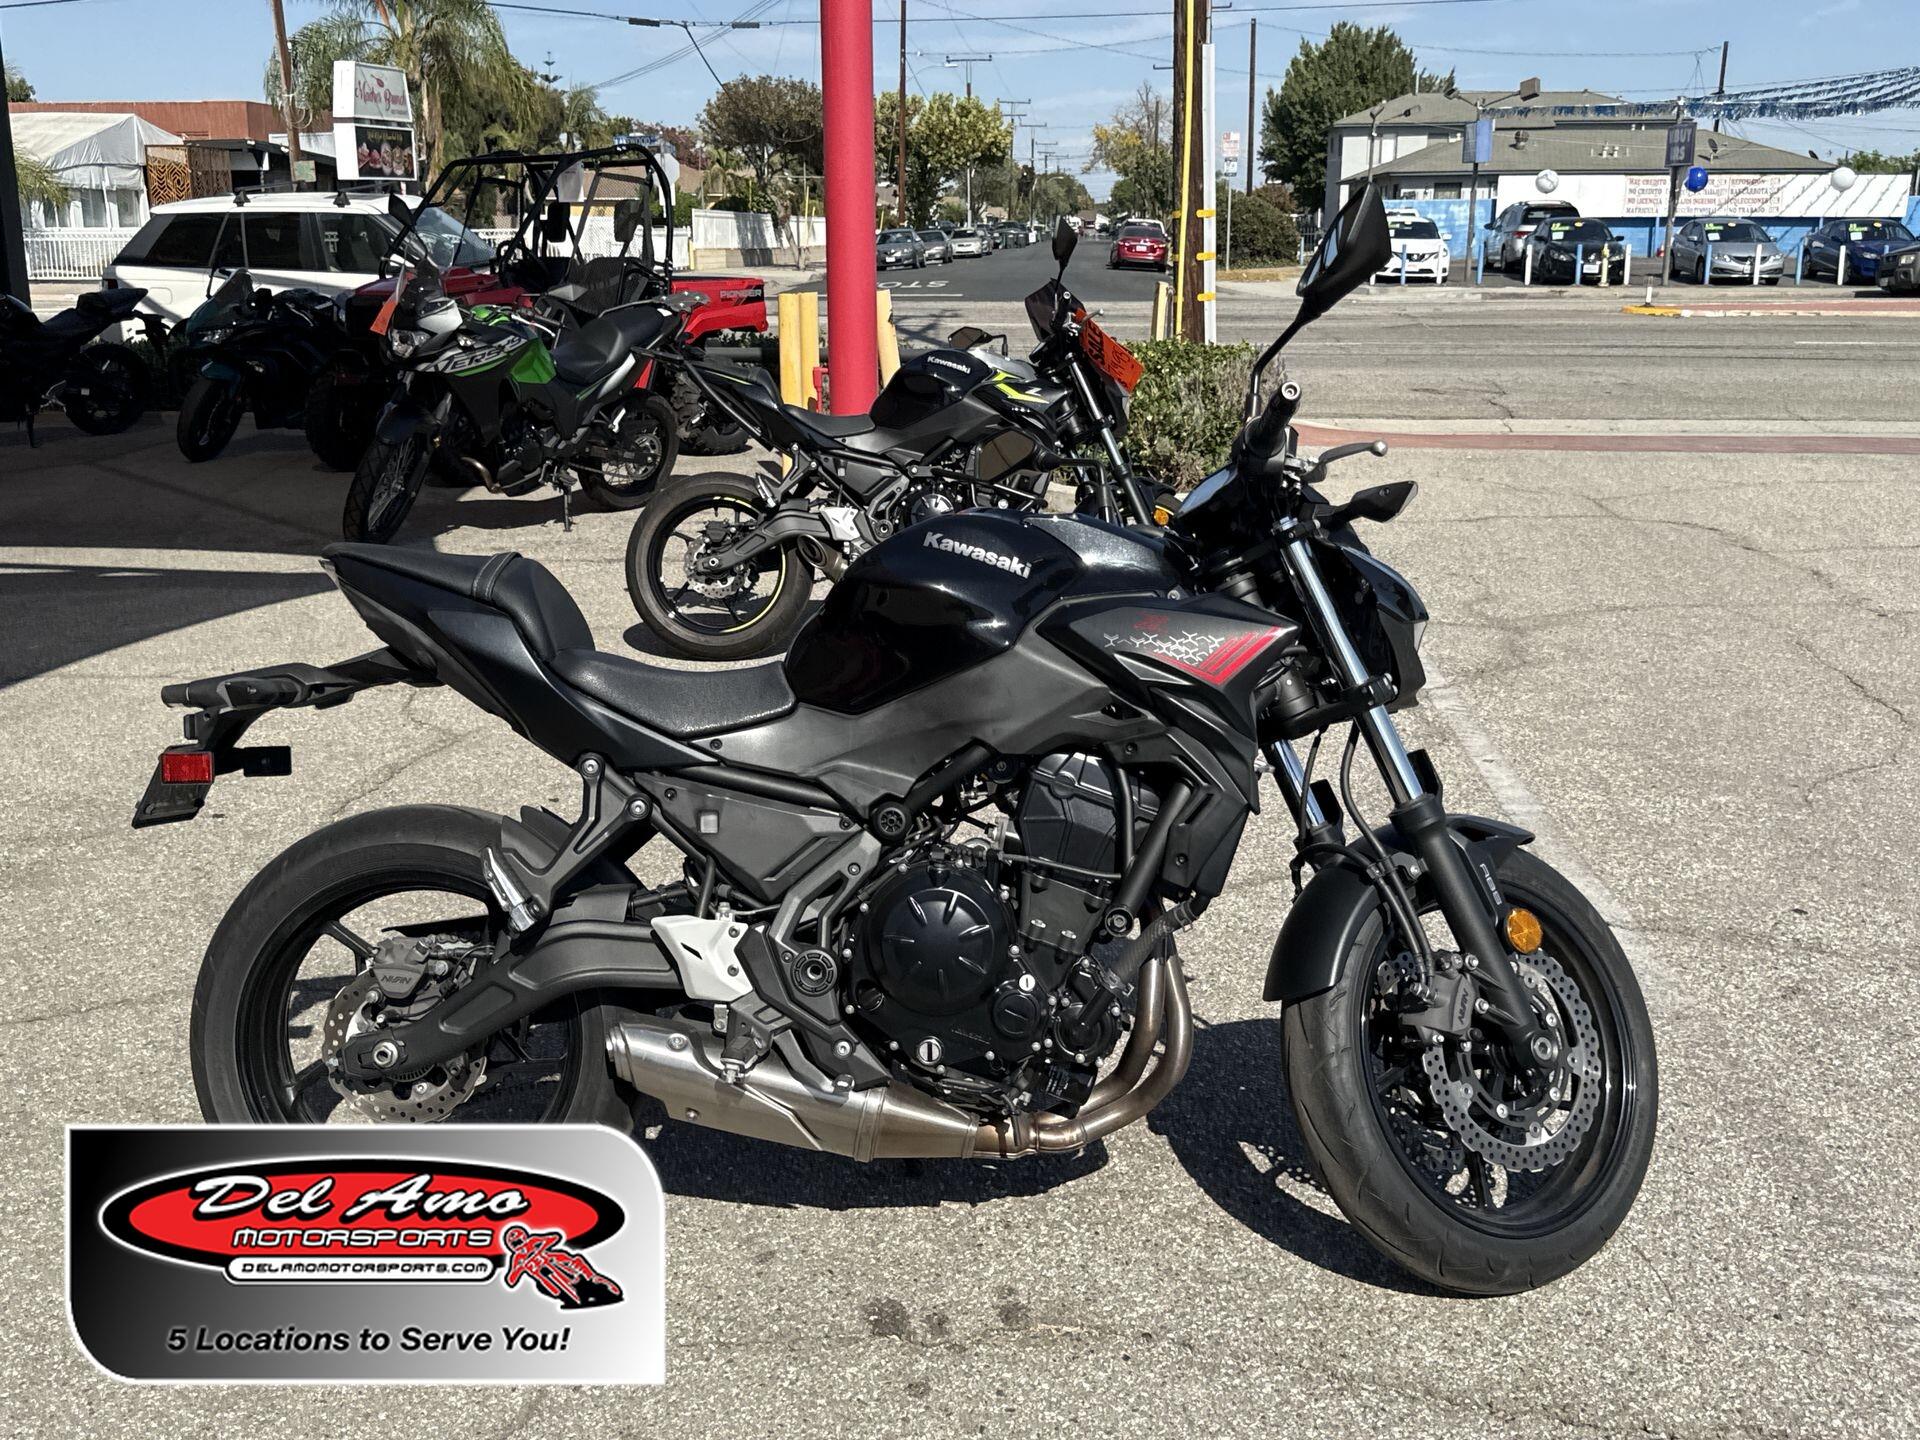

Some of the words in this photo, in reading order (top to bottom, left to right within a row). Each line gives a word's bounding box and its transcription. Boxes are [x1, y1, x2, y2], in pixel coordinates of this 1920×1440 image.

[877, 280, 950, 289] STO
[926, 355, 971, 375] Kawasaki
[923, 531, 1033, 580] Kawasaki
[1480, 863, 1503, 906] ABS
